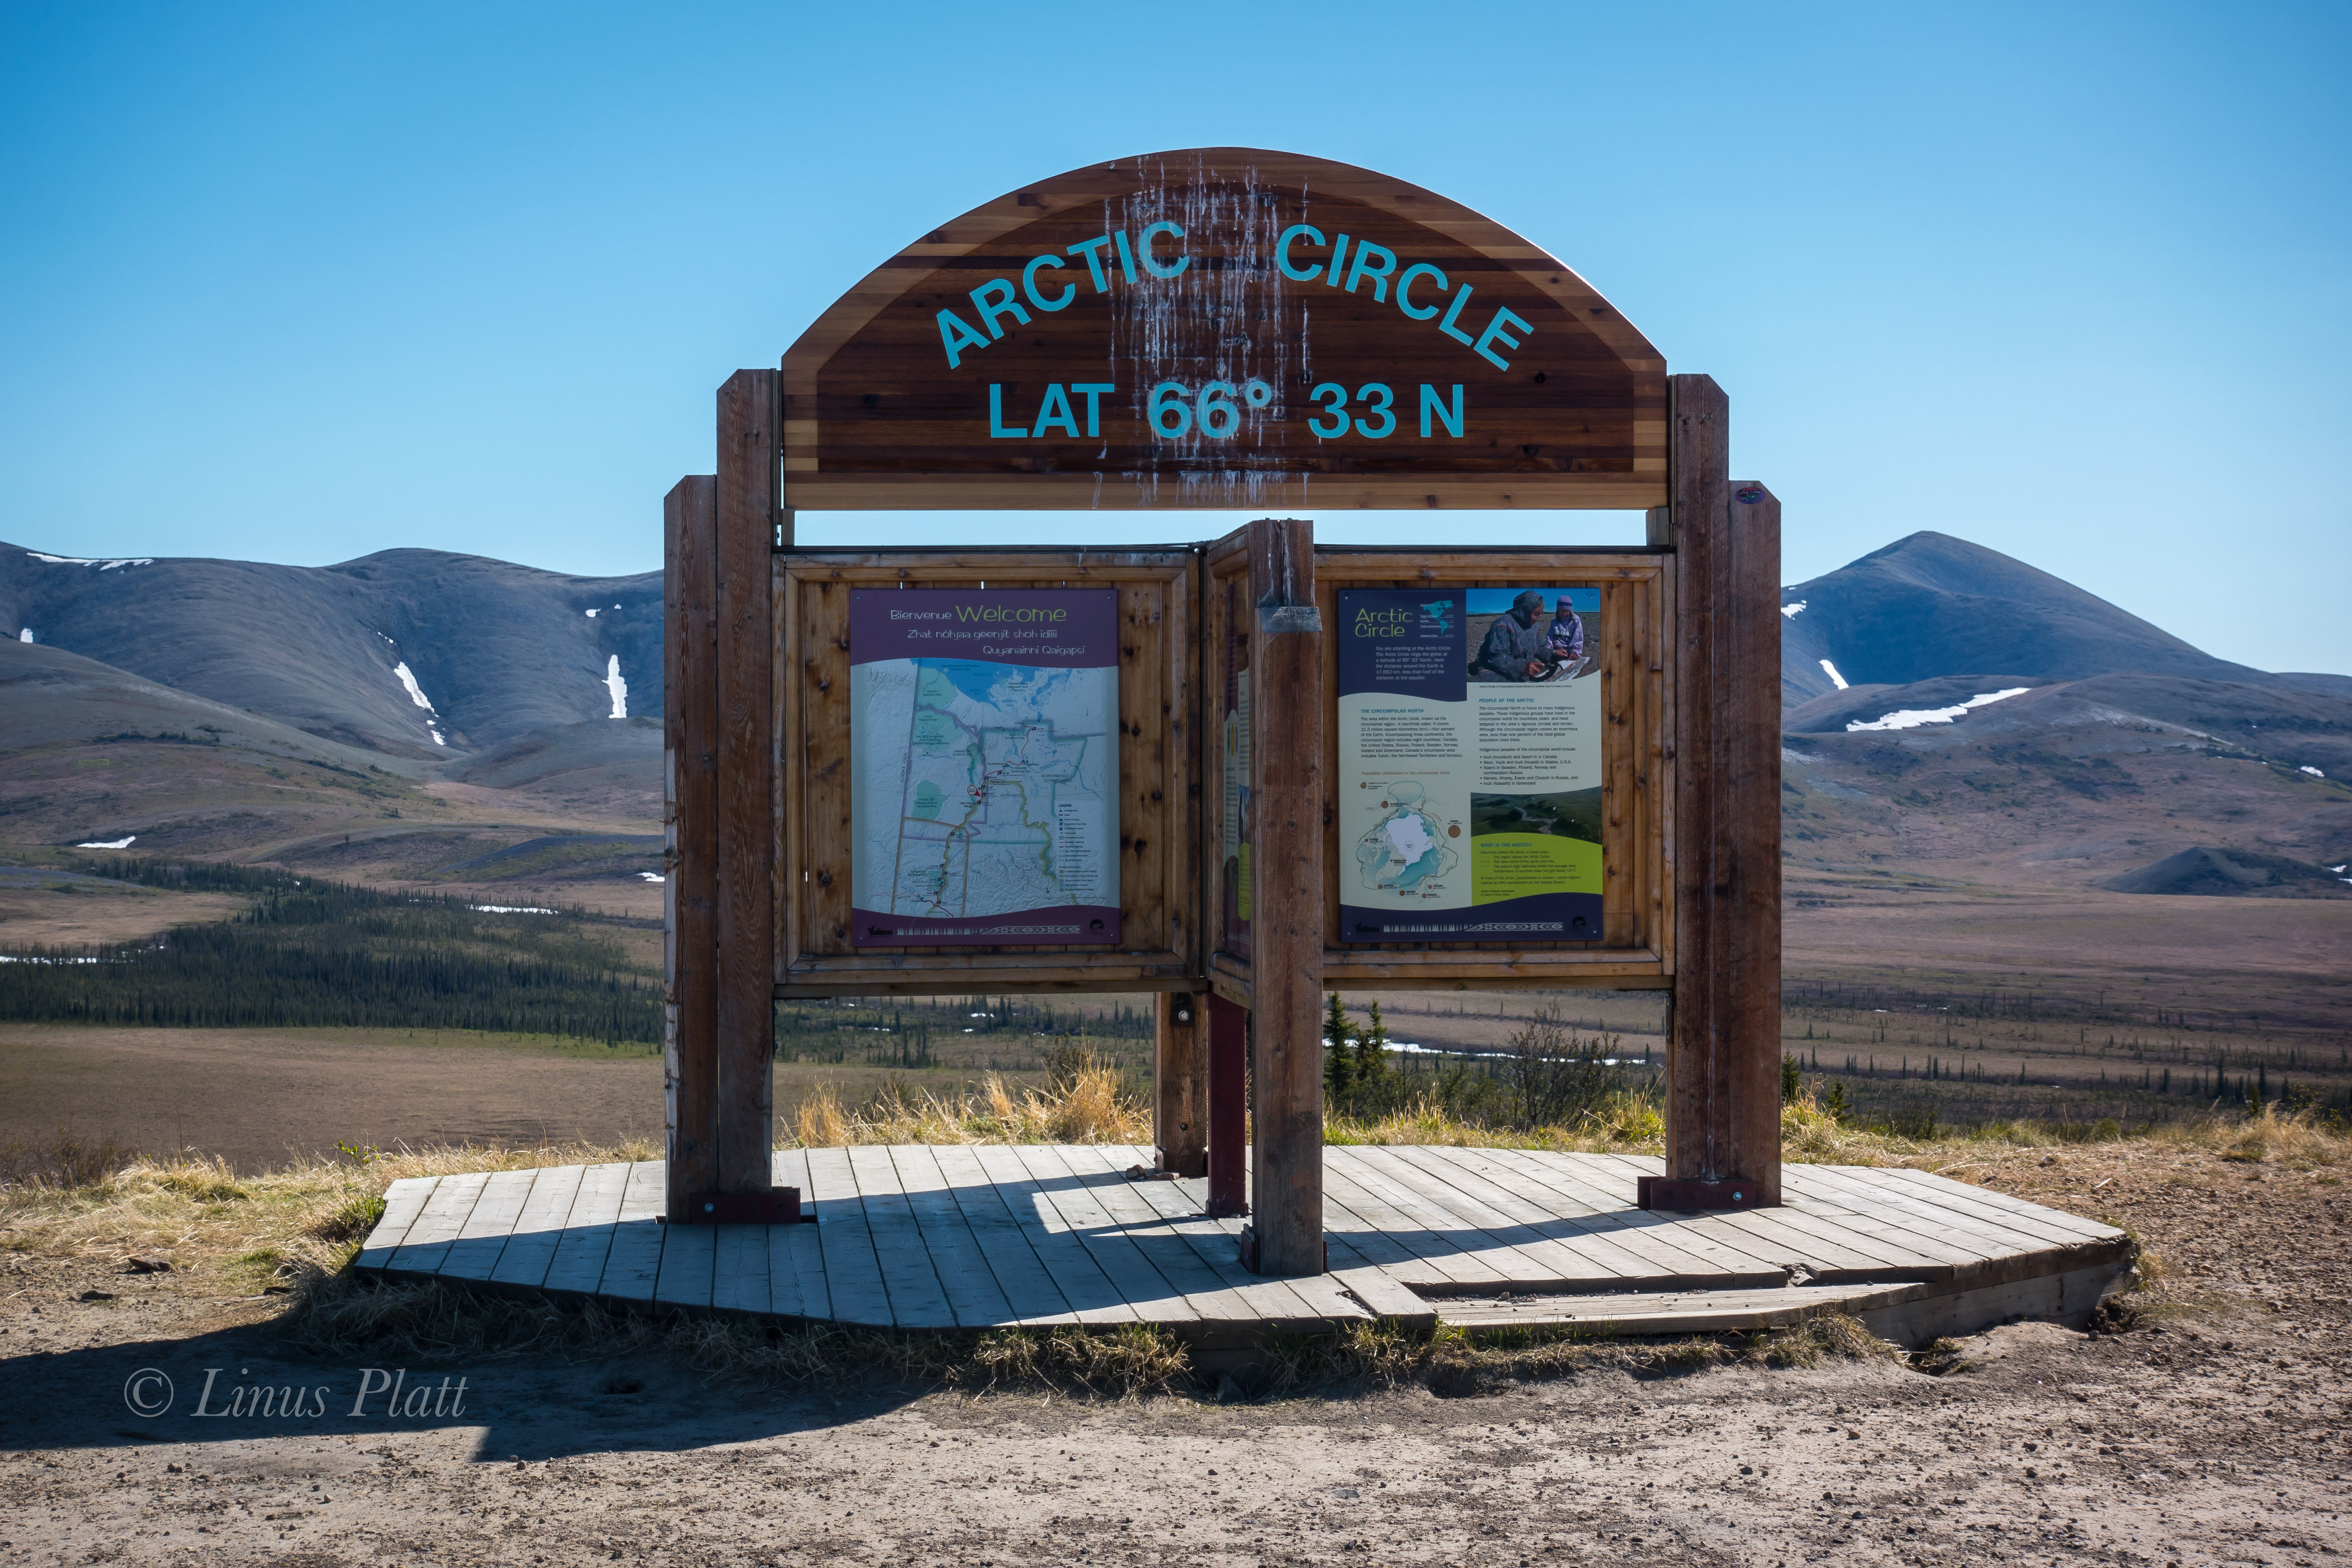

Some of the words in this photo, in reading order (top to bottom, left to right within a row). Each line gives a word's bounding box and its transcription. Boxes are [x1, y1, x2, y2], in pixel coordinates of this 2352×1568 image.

[936, 221, 1190, 369] ARCTIC
[1277, 224, 1534, 371] CIRCLE
[989, 383, 1115, 438] LAT
[1148, 380, 1272, 438] 66°
[1309, 383, 1396, 438] 33
[1420, 384, 1463, 438] N
[891, 610, 952, 620] Bienvenue
[956, 605, 1067, 622] Welcome
[1355, 608, 1414, 623] Arctic
[907, 629, 933, 638] Zhat
[936, 629, 971, 640] nòhjaa
[974, 630, 1010, 640] geenjit
[1014, 629, 1037, 638] shoh
[1355, 623, 1406, 637] Circle
[983, 646, 1039, 656] Quyanainni
[1042, 646, 1085, 655] Qaigapsi
